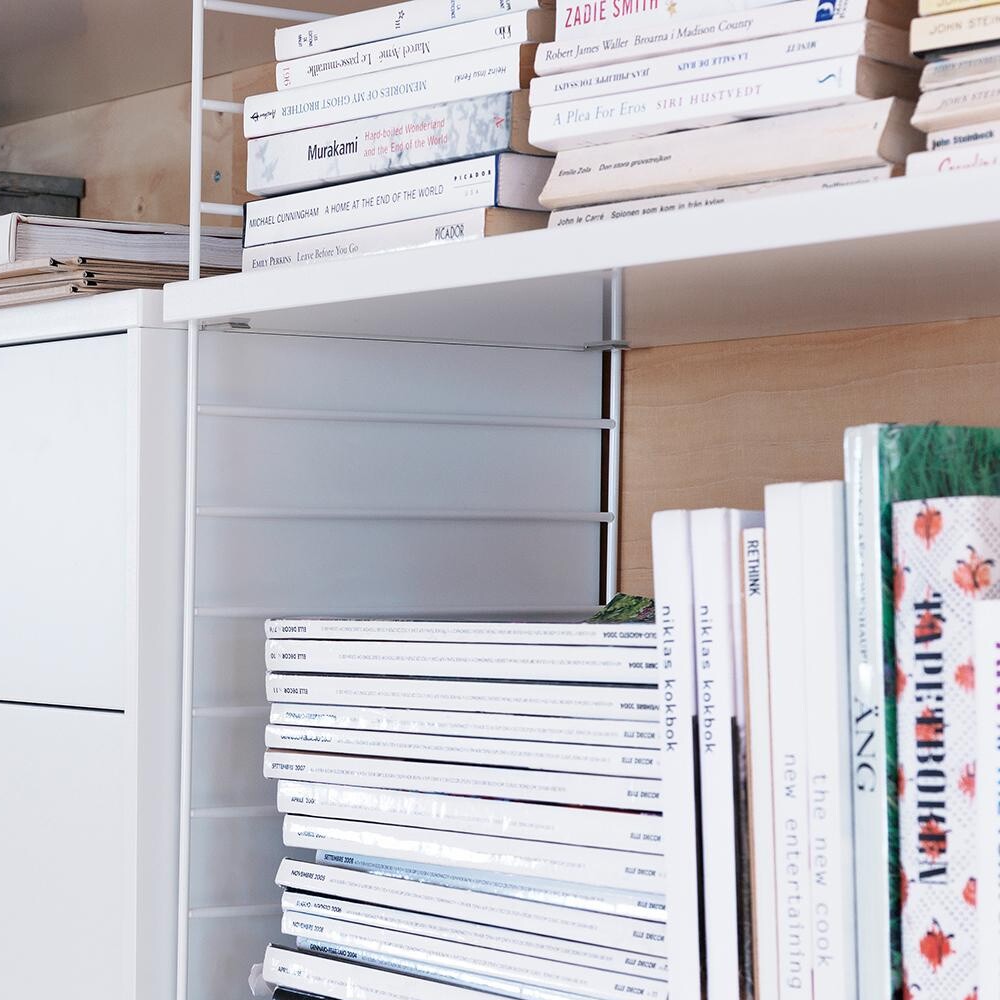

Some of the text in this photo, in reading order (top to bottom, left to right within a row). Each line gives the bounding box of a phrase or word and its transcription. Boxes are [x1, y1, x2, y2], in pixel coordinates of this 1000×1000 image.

[564, 3, 606, 28] ZADIE
[402, 40, 431, 58] Marcel
[545, 47, 573, 62] Robert
[575, 43, 599, 58] James
[602, 37, 628, 51] Waller
[634, 32, 669, 46] Broarna
[677, 25, 716, 41] Madison
[718, 19, 754, 33] County
[282, 80, 427, 117] MEMORIES OF MY GHOST BROTHER
[553, 84, 763, 126] A Plea For Eros SIRI HUSTVEDT
[364, 118, 445, 141] Hard-boiled Wonderland
[364, 146, 376, 158] and
[378, 144, 389, 157] the
[390, 141, 401, 155] End
[414, 138, 427, 151] the
[428, 133, 448, 149] World
[307, 136, 359, 162] Murakami
[453, 169, 492, 182] PICADOR
[558, 168, 577, 178] Emile
[599, 163, 613, 172] Den
[249, 216, 275, 229] MICHAEL
[276, 208, 319, 225] CUNNINGHAM
[331, 201, 350, 213] HOME
[361, 196, 375, 209] THE
[376, 194, 390, 207] END
[391, 192, 402, 204] OF
[403, 189, 417, 202] THE
[418, 184, 444, 199] WORLD
[557, 217, 575, 227] John
[611, 209, 640, 220] Spionen
[642, 207, 659, 216] som
[659, 204, 675, 213] kom
[434, 225, 465, 241] PICADOR
[252, 243, 359, 270] EMILY PERKINS Leave Before You Go
[747, 539, 760, 597] RETHINK
[282, 625, 297, 633] DECOR
[281, 652, 297, 660] DECOR
[662, 605, 678, 752] niklas kokbok
[699, 605, 715, 754] niklas kokbok
[854, 698, 878, 793] ÄNG
[784, 753, 800, 799] new
[812, 773, 829, 820] the
[814, 837, 831, 886] new
[784, 818, 805, 990] entertaining
[815, 903, 834, 969] cook
